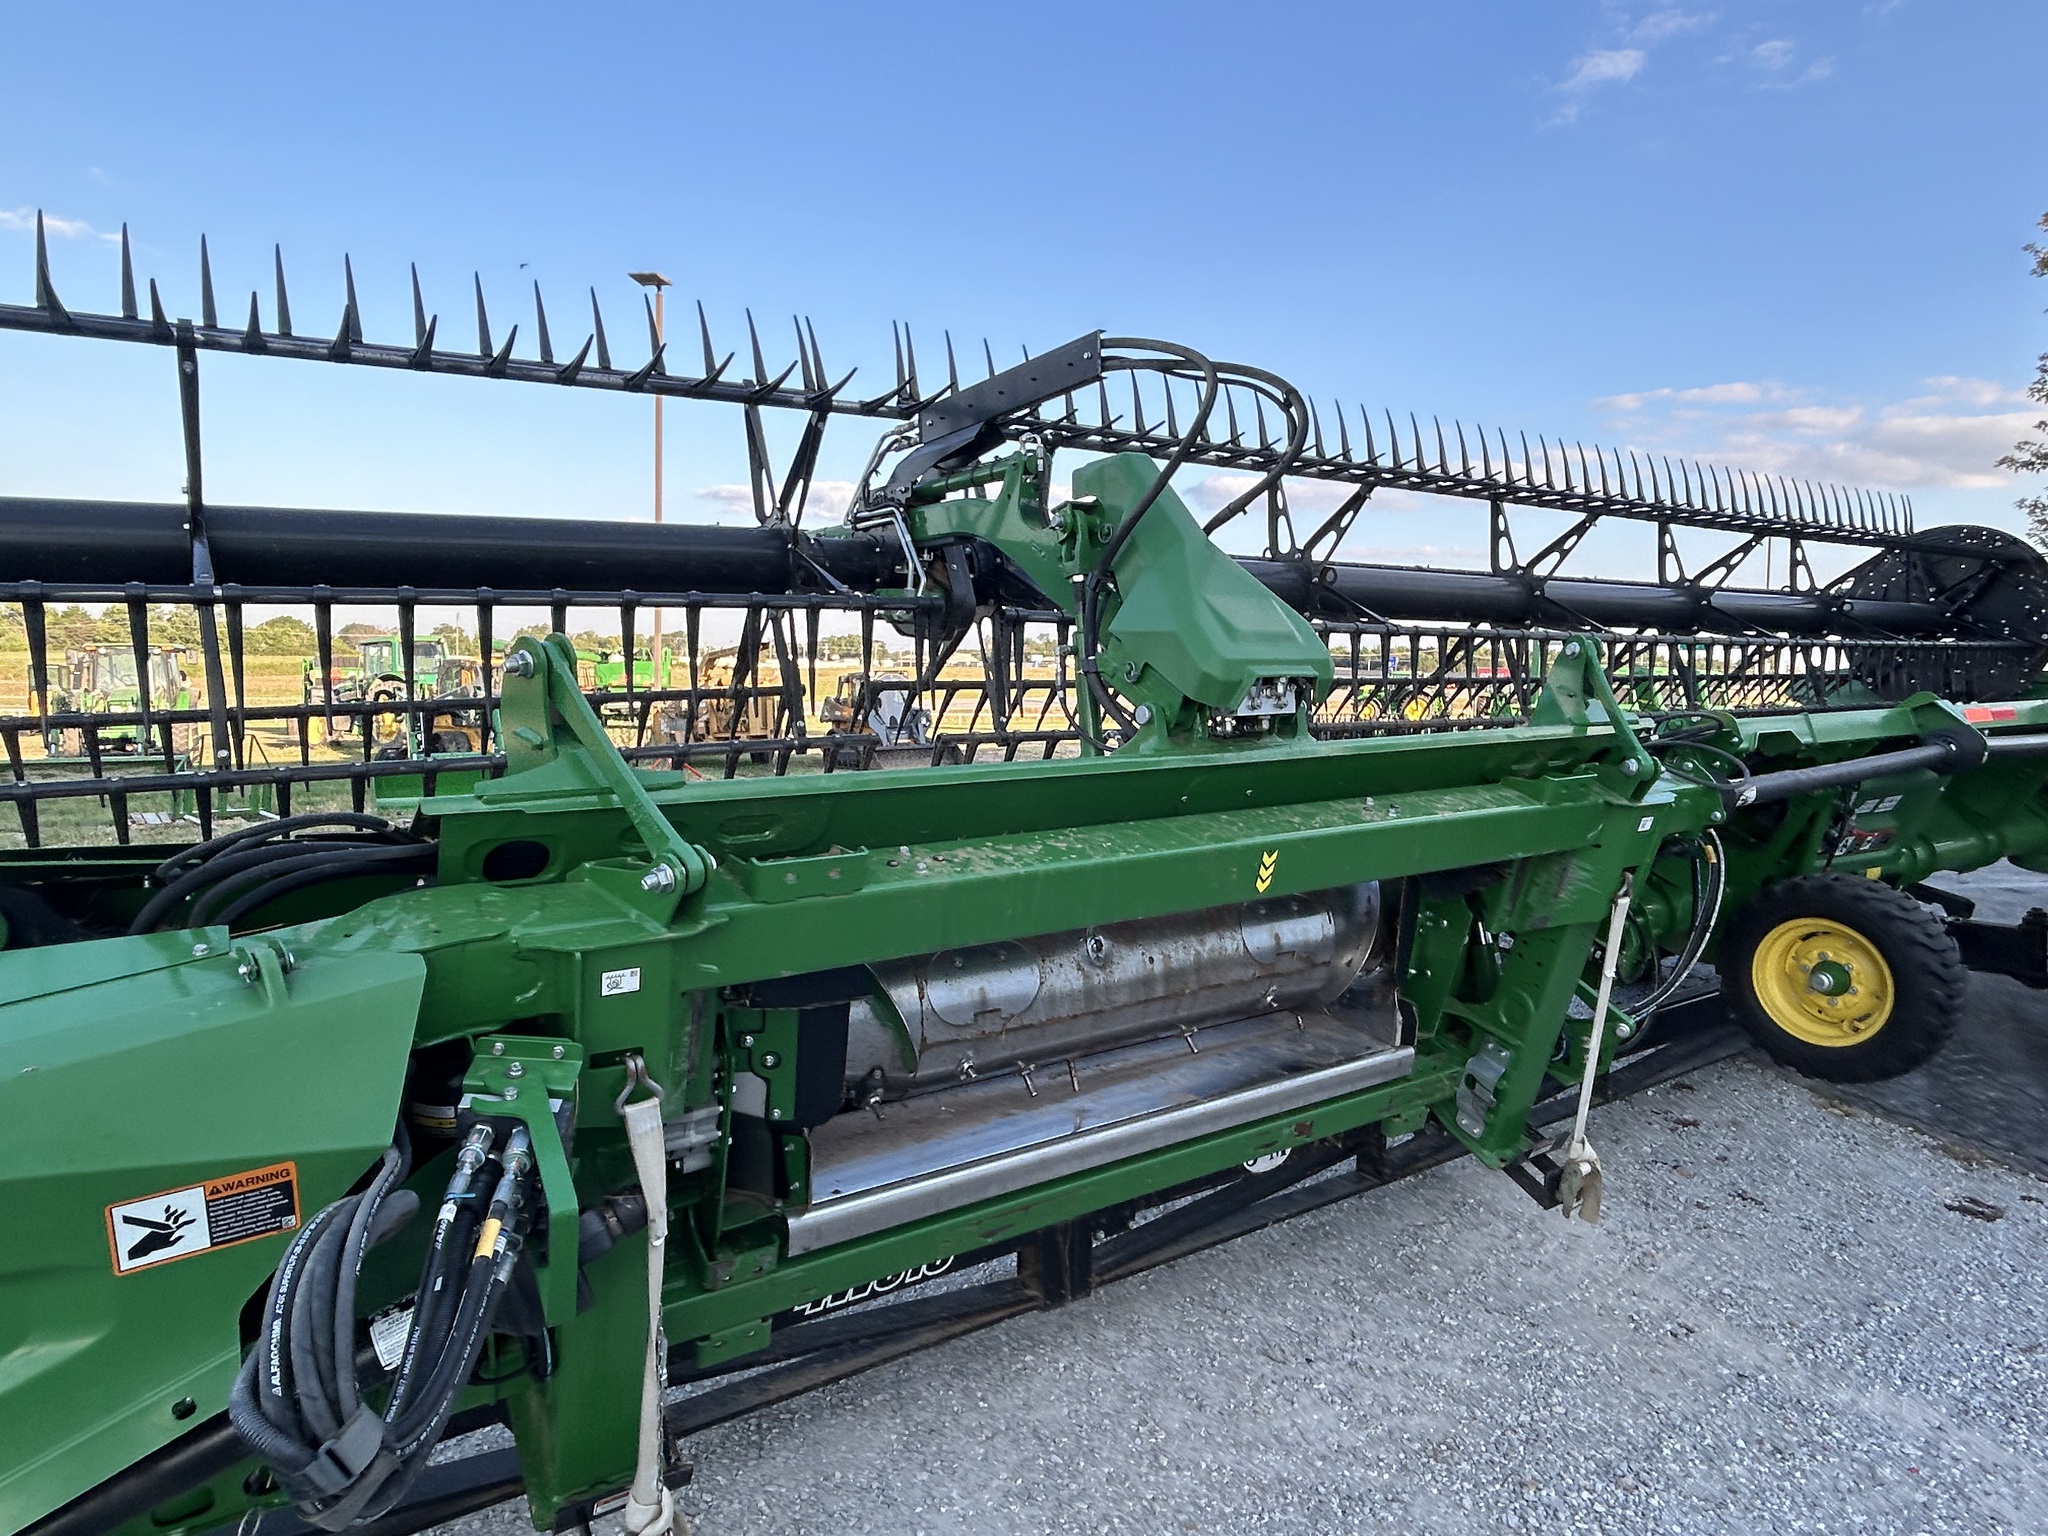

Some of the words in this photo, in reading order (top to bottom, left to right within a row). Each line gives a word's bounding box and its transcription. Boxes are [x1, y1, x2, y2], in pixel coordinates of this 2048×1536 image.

[221, 1168, 291, 1191] WARNING
[402, 1353, 414, 1374] MADE
[410, 1325, 421, 1345] ITALY
